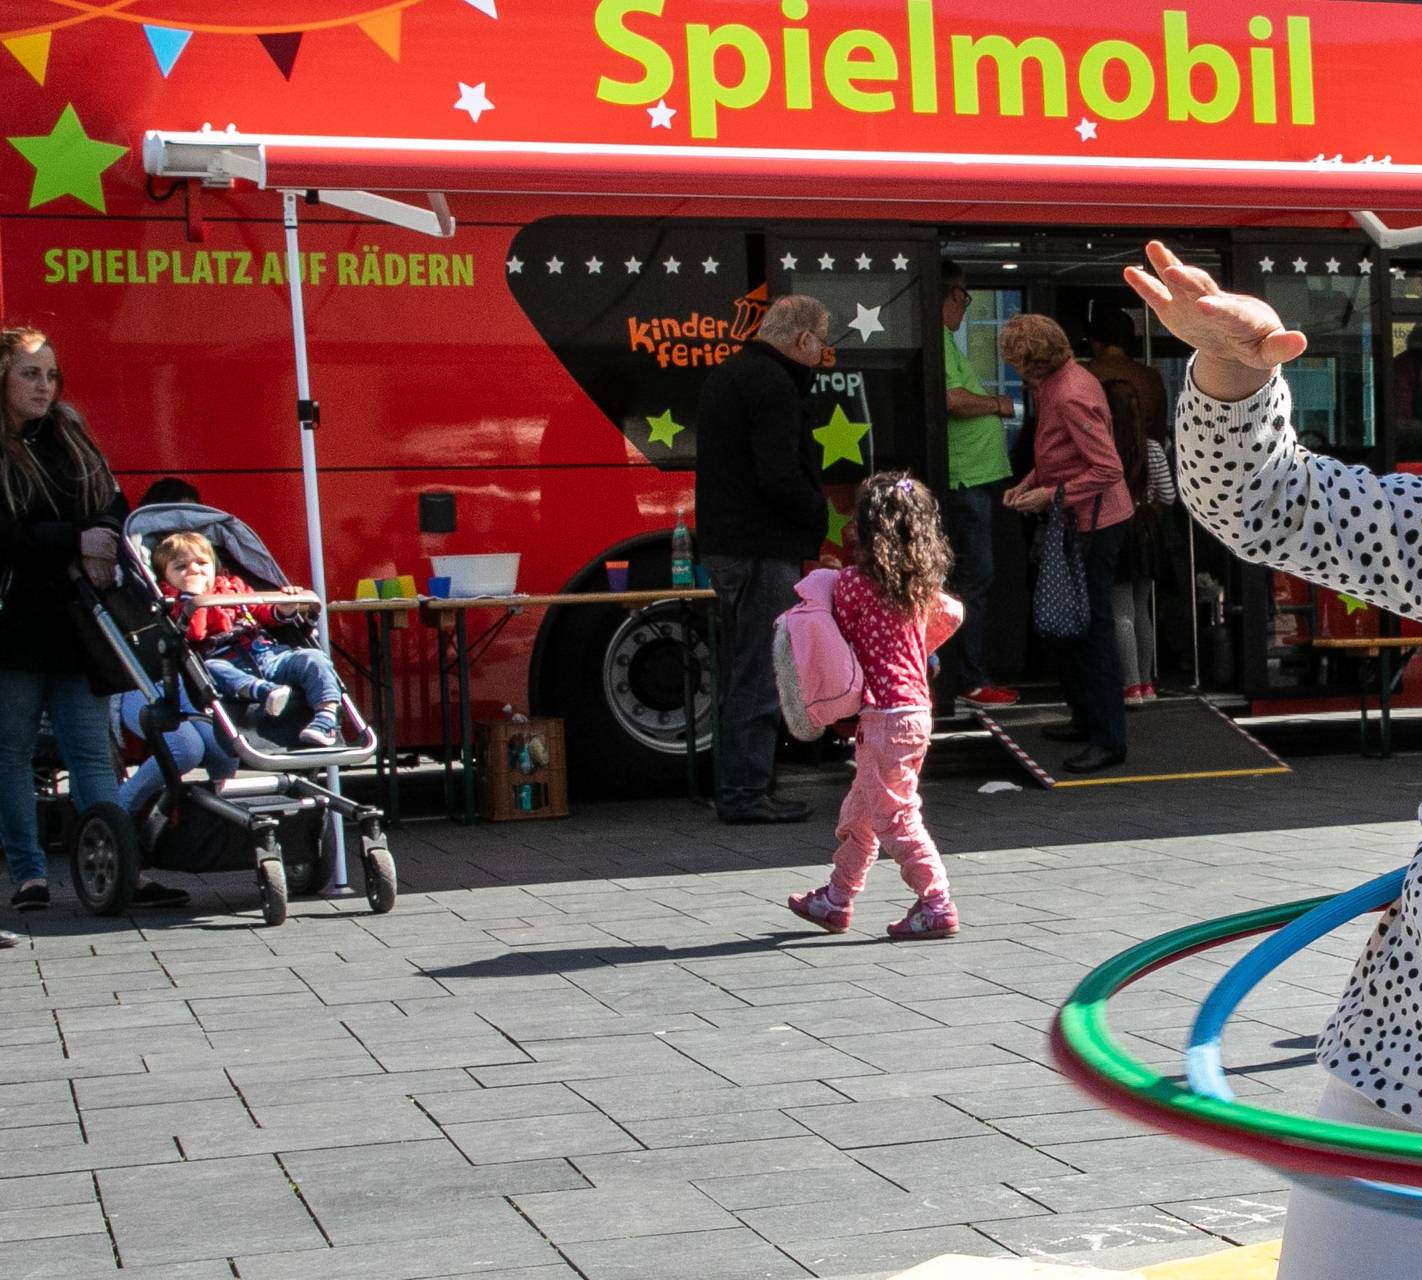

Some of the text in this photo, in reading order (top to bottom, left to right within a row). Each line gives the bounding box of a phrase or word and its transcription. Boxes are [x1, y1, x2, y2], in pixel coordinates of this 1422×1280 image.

[595, 0, 1316, 139] Spielmobil
[44, 249, 253, 284] SPIELPLATZ
[338, 245, 474, 287] RÄDERN
